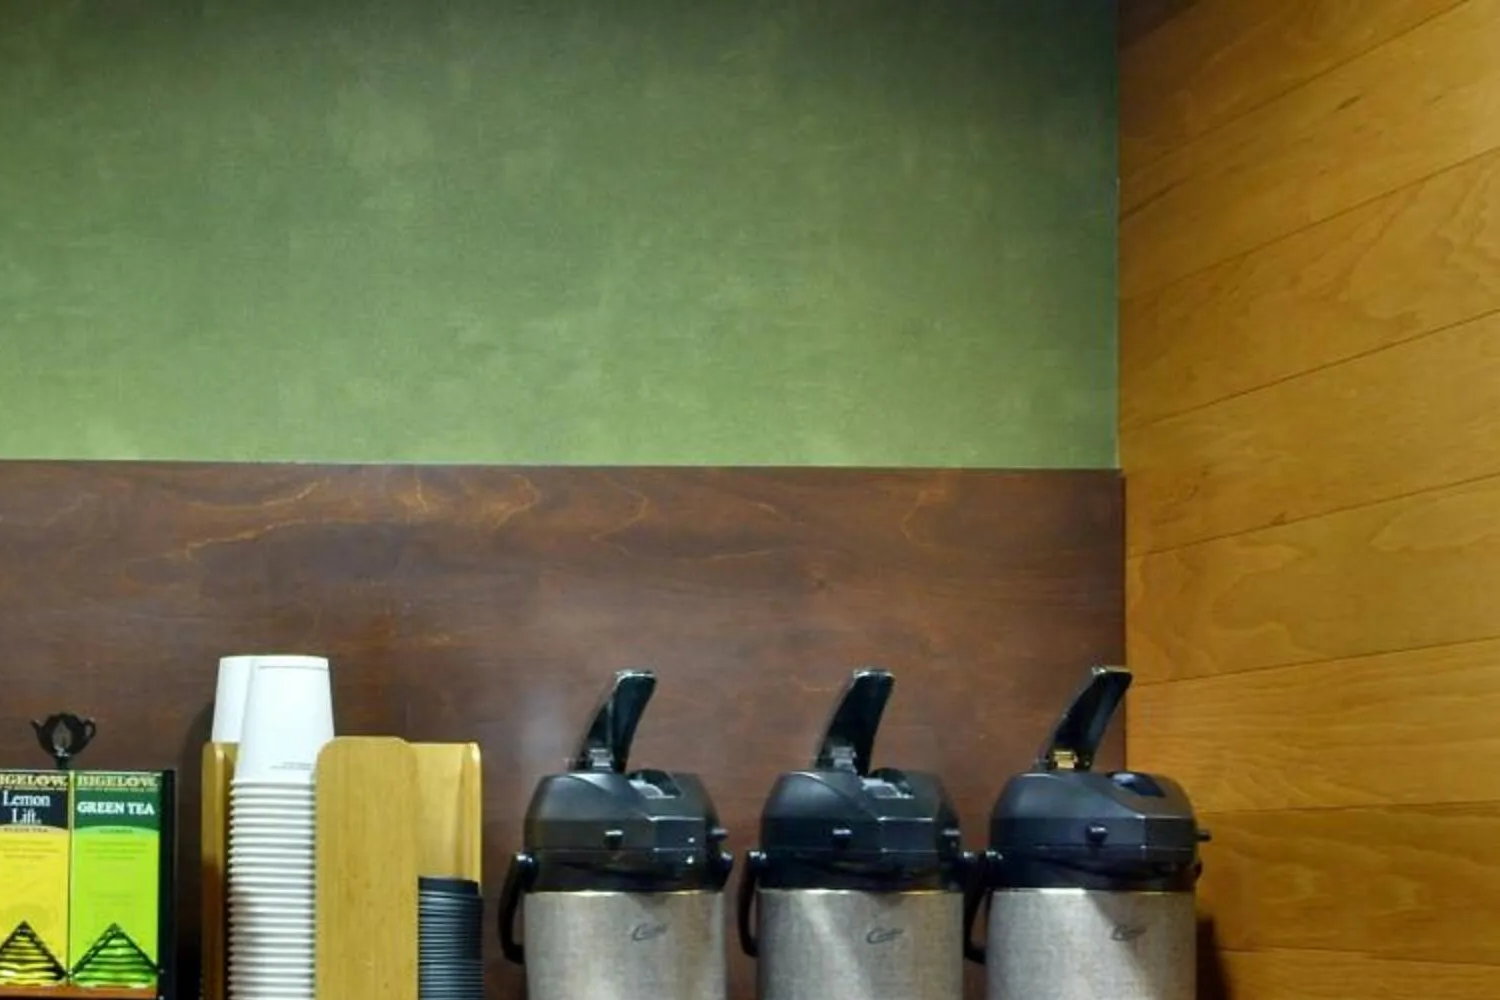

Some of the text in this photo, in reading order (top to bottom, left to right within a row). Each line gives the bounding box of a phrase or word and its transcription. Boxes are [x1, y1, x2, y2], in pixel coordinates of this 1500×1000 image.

[3, 790, 50, 806] Lemon
[77, 801, 155, 815] GREEN TEA
